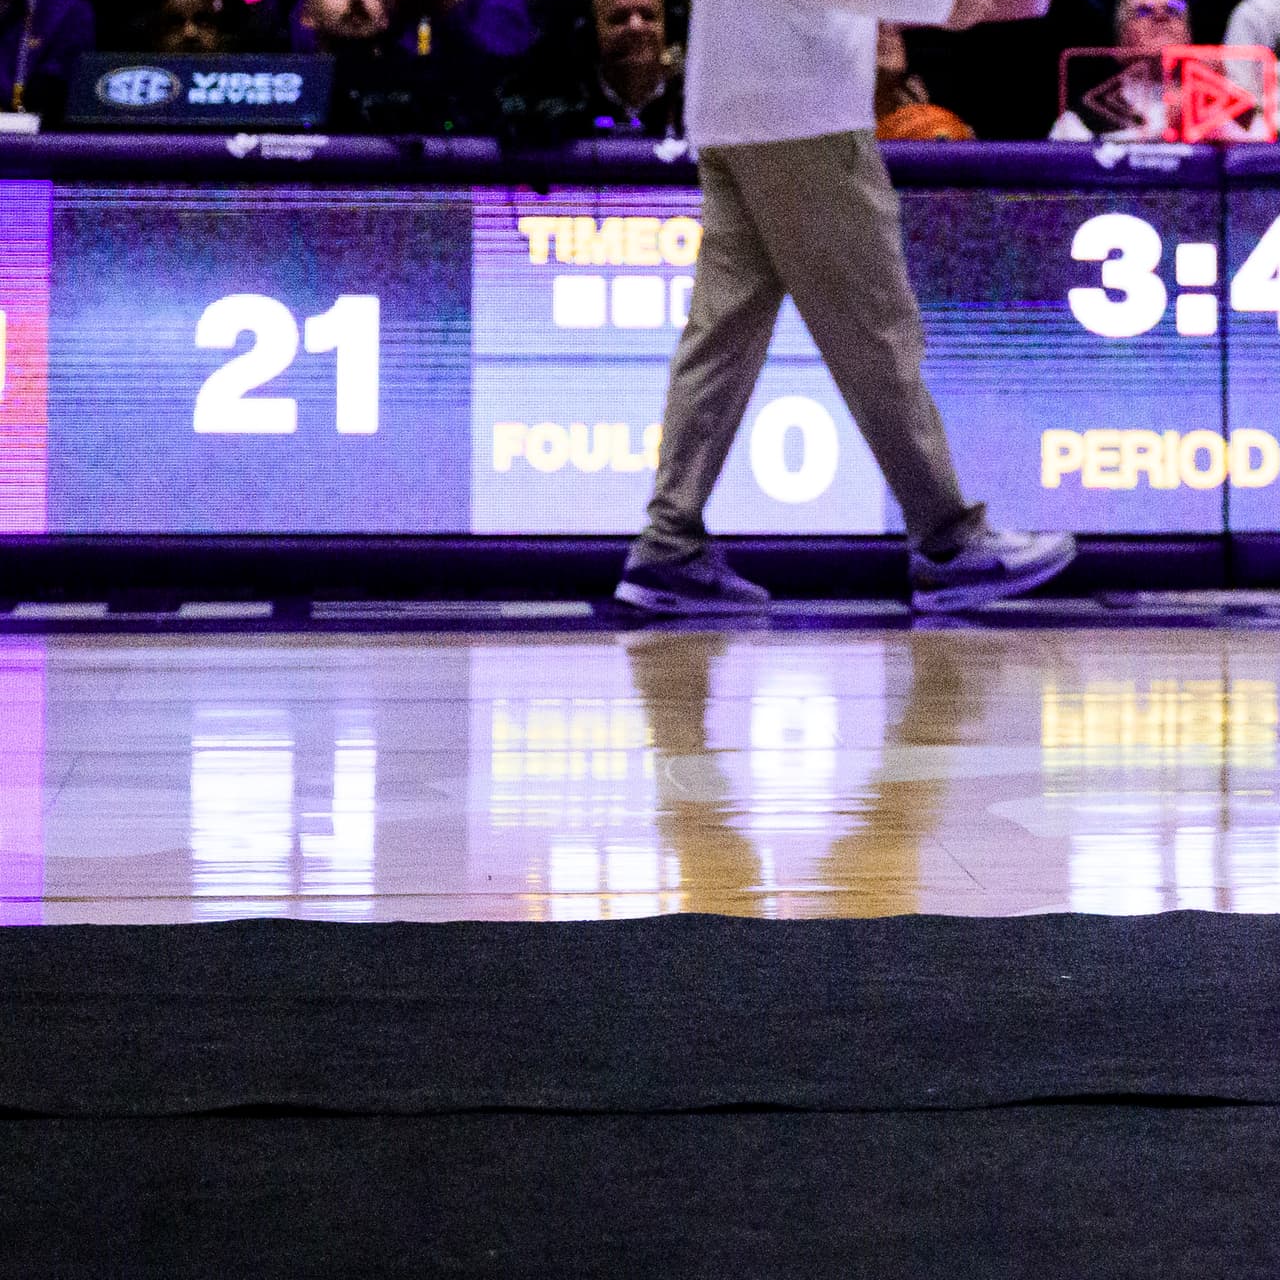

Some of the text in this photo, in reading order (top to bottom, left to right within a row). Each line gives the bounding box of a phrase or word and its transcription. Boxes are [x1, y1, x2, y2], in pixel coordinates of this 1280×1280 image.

[518, 216, 703, 266] TIMEO
[193, 293, 381, 434] 21
[750, 395, 839, 505] 0
